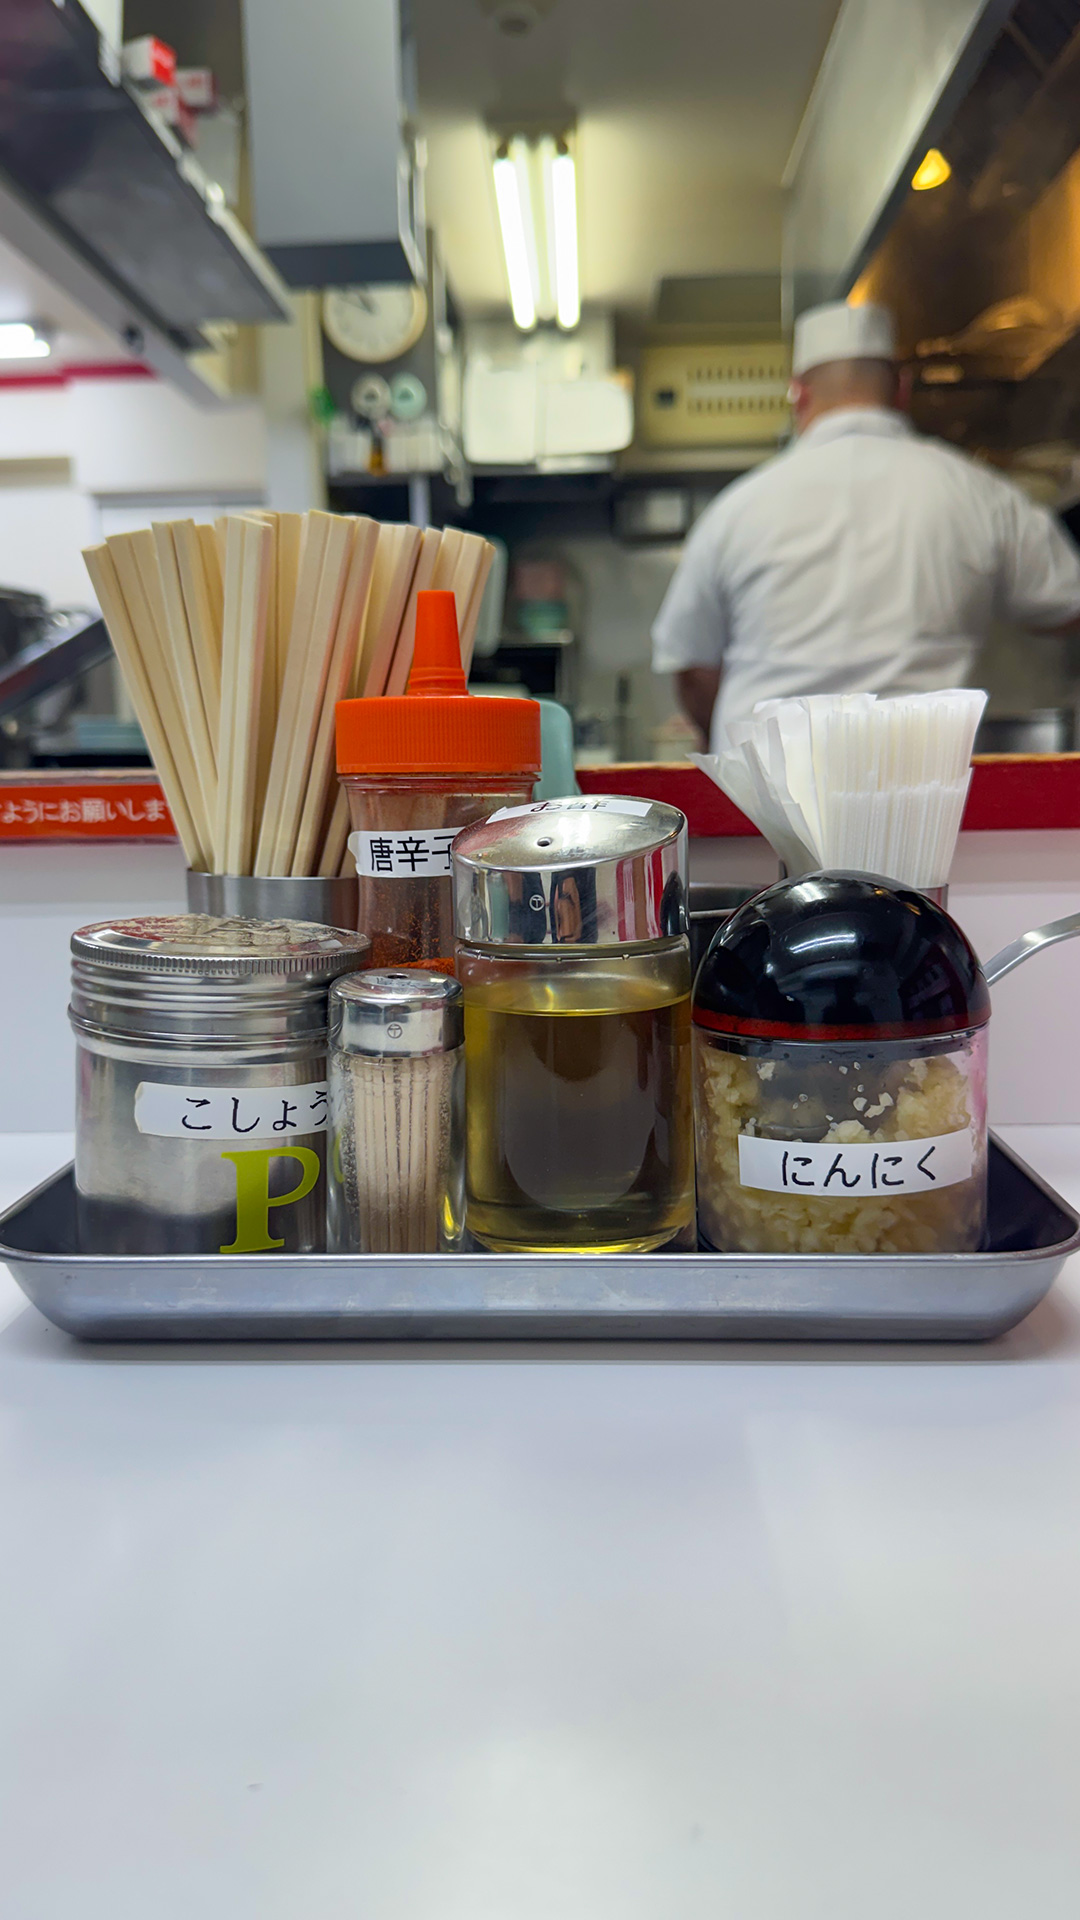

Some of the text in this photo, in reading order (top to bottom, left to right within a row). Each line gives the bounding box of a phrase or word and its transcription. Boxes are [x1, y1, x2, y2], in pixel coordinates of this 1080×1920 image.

[0, 798, 166, 824] ようにお願いしま
[782, 1146, 936, 1189] にんにく
